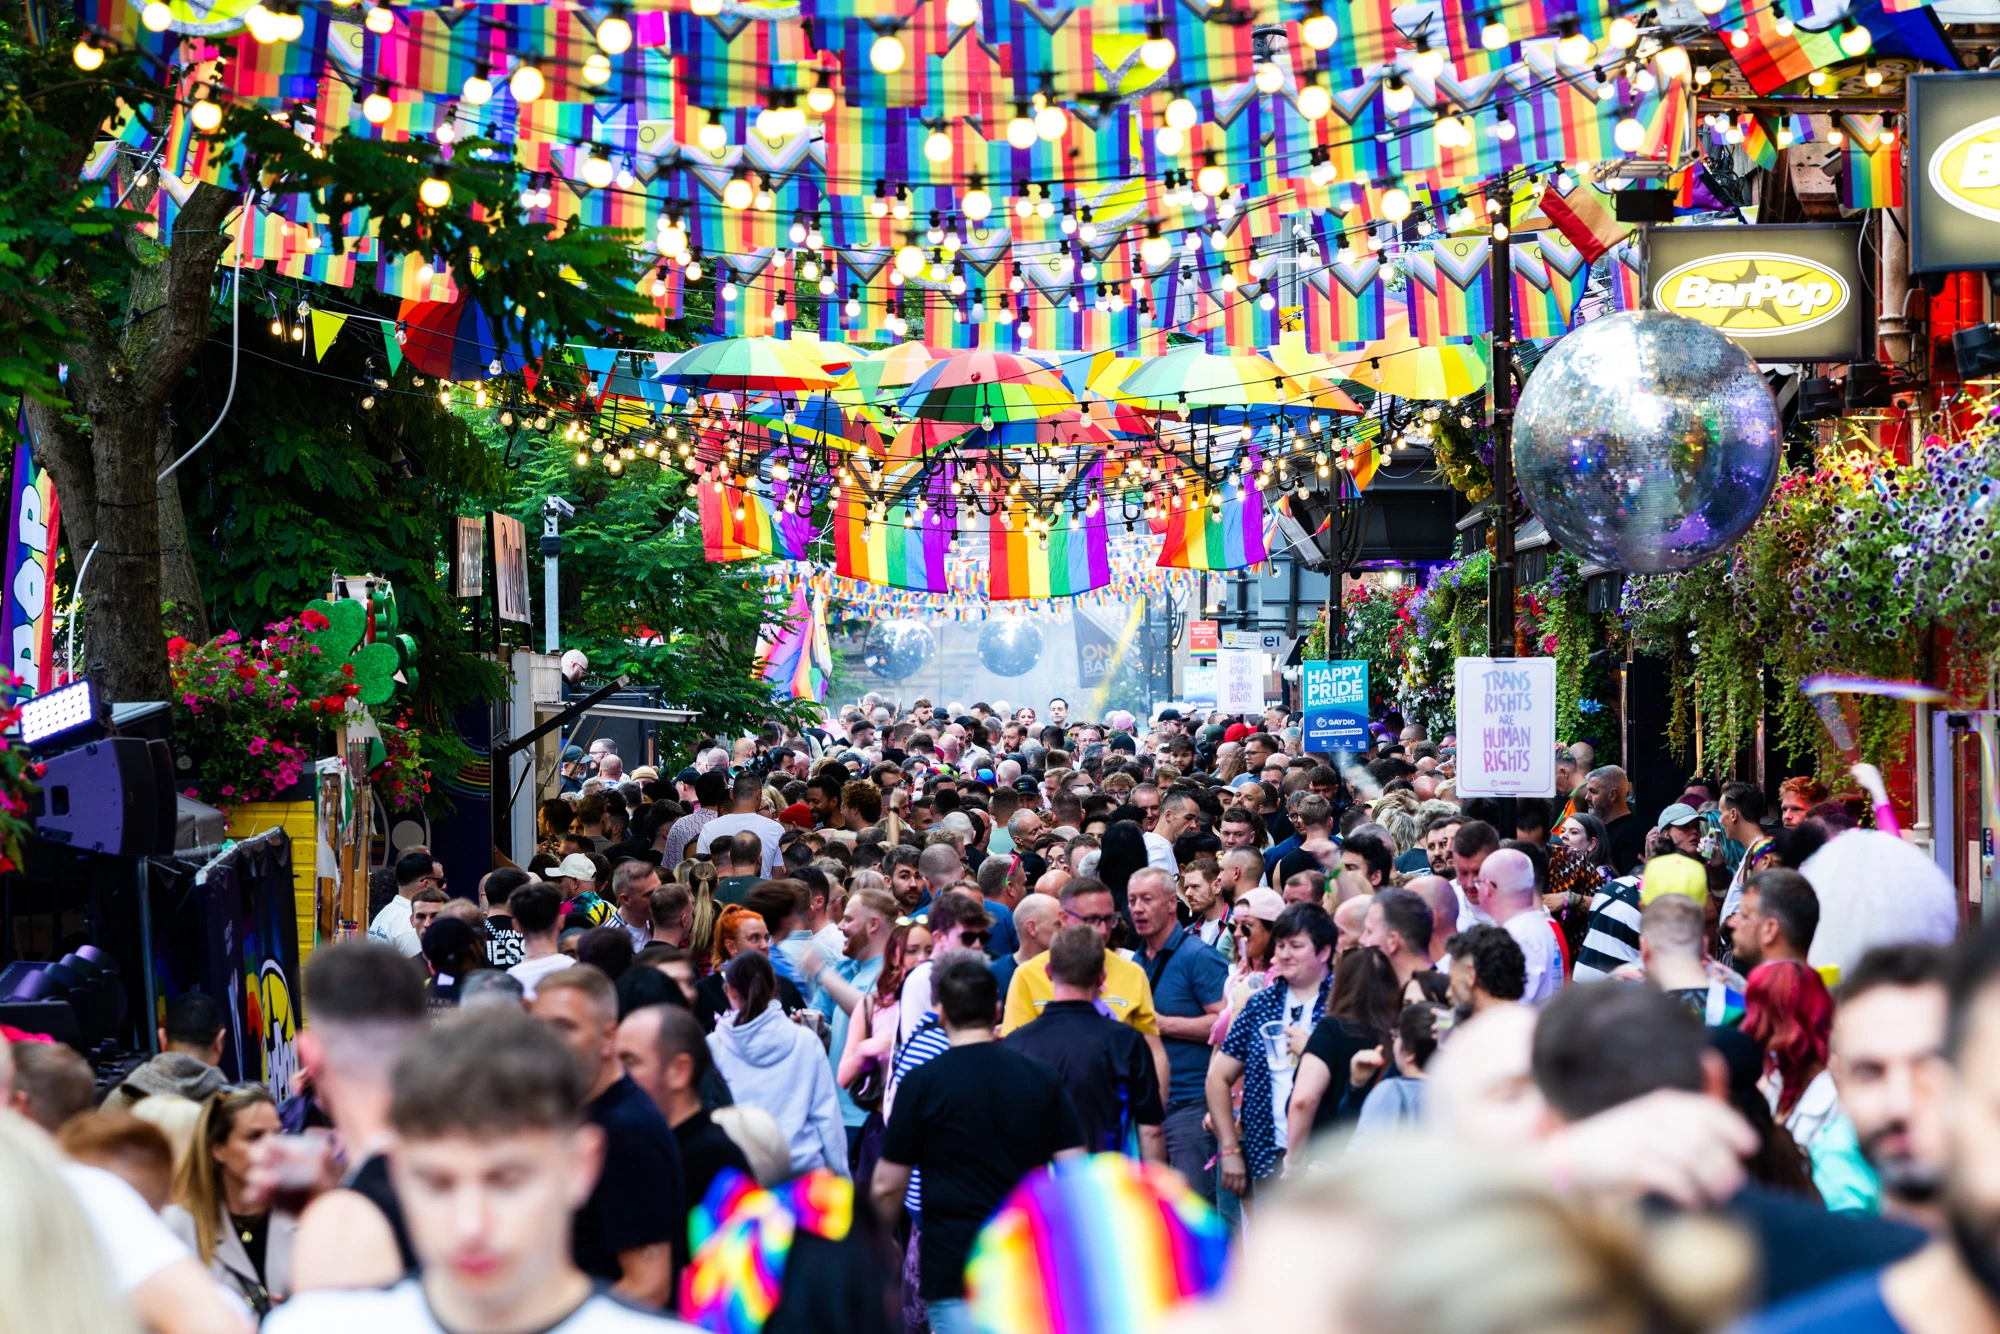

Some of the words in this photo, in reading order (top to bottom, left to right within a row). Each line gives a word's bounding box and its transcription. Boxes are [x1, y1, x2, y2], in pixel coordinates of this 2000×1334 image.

[1958, 142, 2000, 188] B
[1673, 275, 1833, 315] BarPop
[13, 484, 47, 706] POP
[1081, 643, 1112, 660] ON
[1229, 655, 1251, 665] TRANS
[1083, 658, 1116, 674] BAR
[1229, 665, 1252, 676] RIGHTS
[1307, 665, 1363, 684] HAPPY
[1229, 681, 1252, 692] HUMAN
[1307, 679, 1363, 699] PRIDE
[1482, 670, 1531, 692] TRANS
[1229, 692, 1252, 704] RIGHTS
[1307, 694, 1363, 707] MANCHESTER!
[1484, 692, 1532, 714] RIGHTS
[1498, 714, 1515, 726] ARE
[1483, 726, 1531, 749] HUMAN
[1483, 749, 1531, 773] RIGHTS
